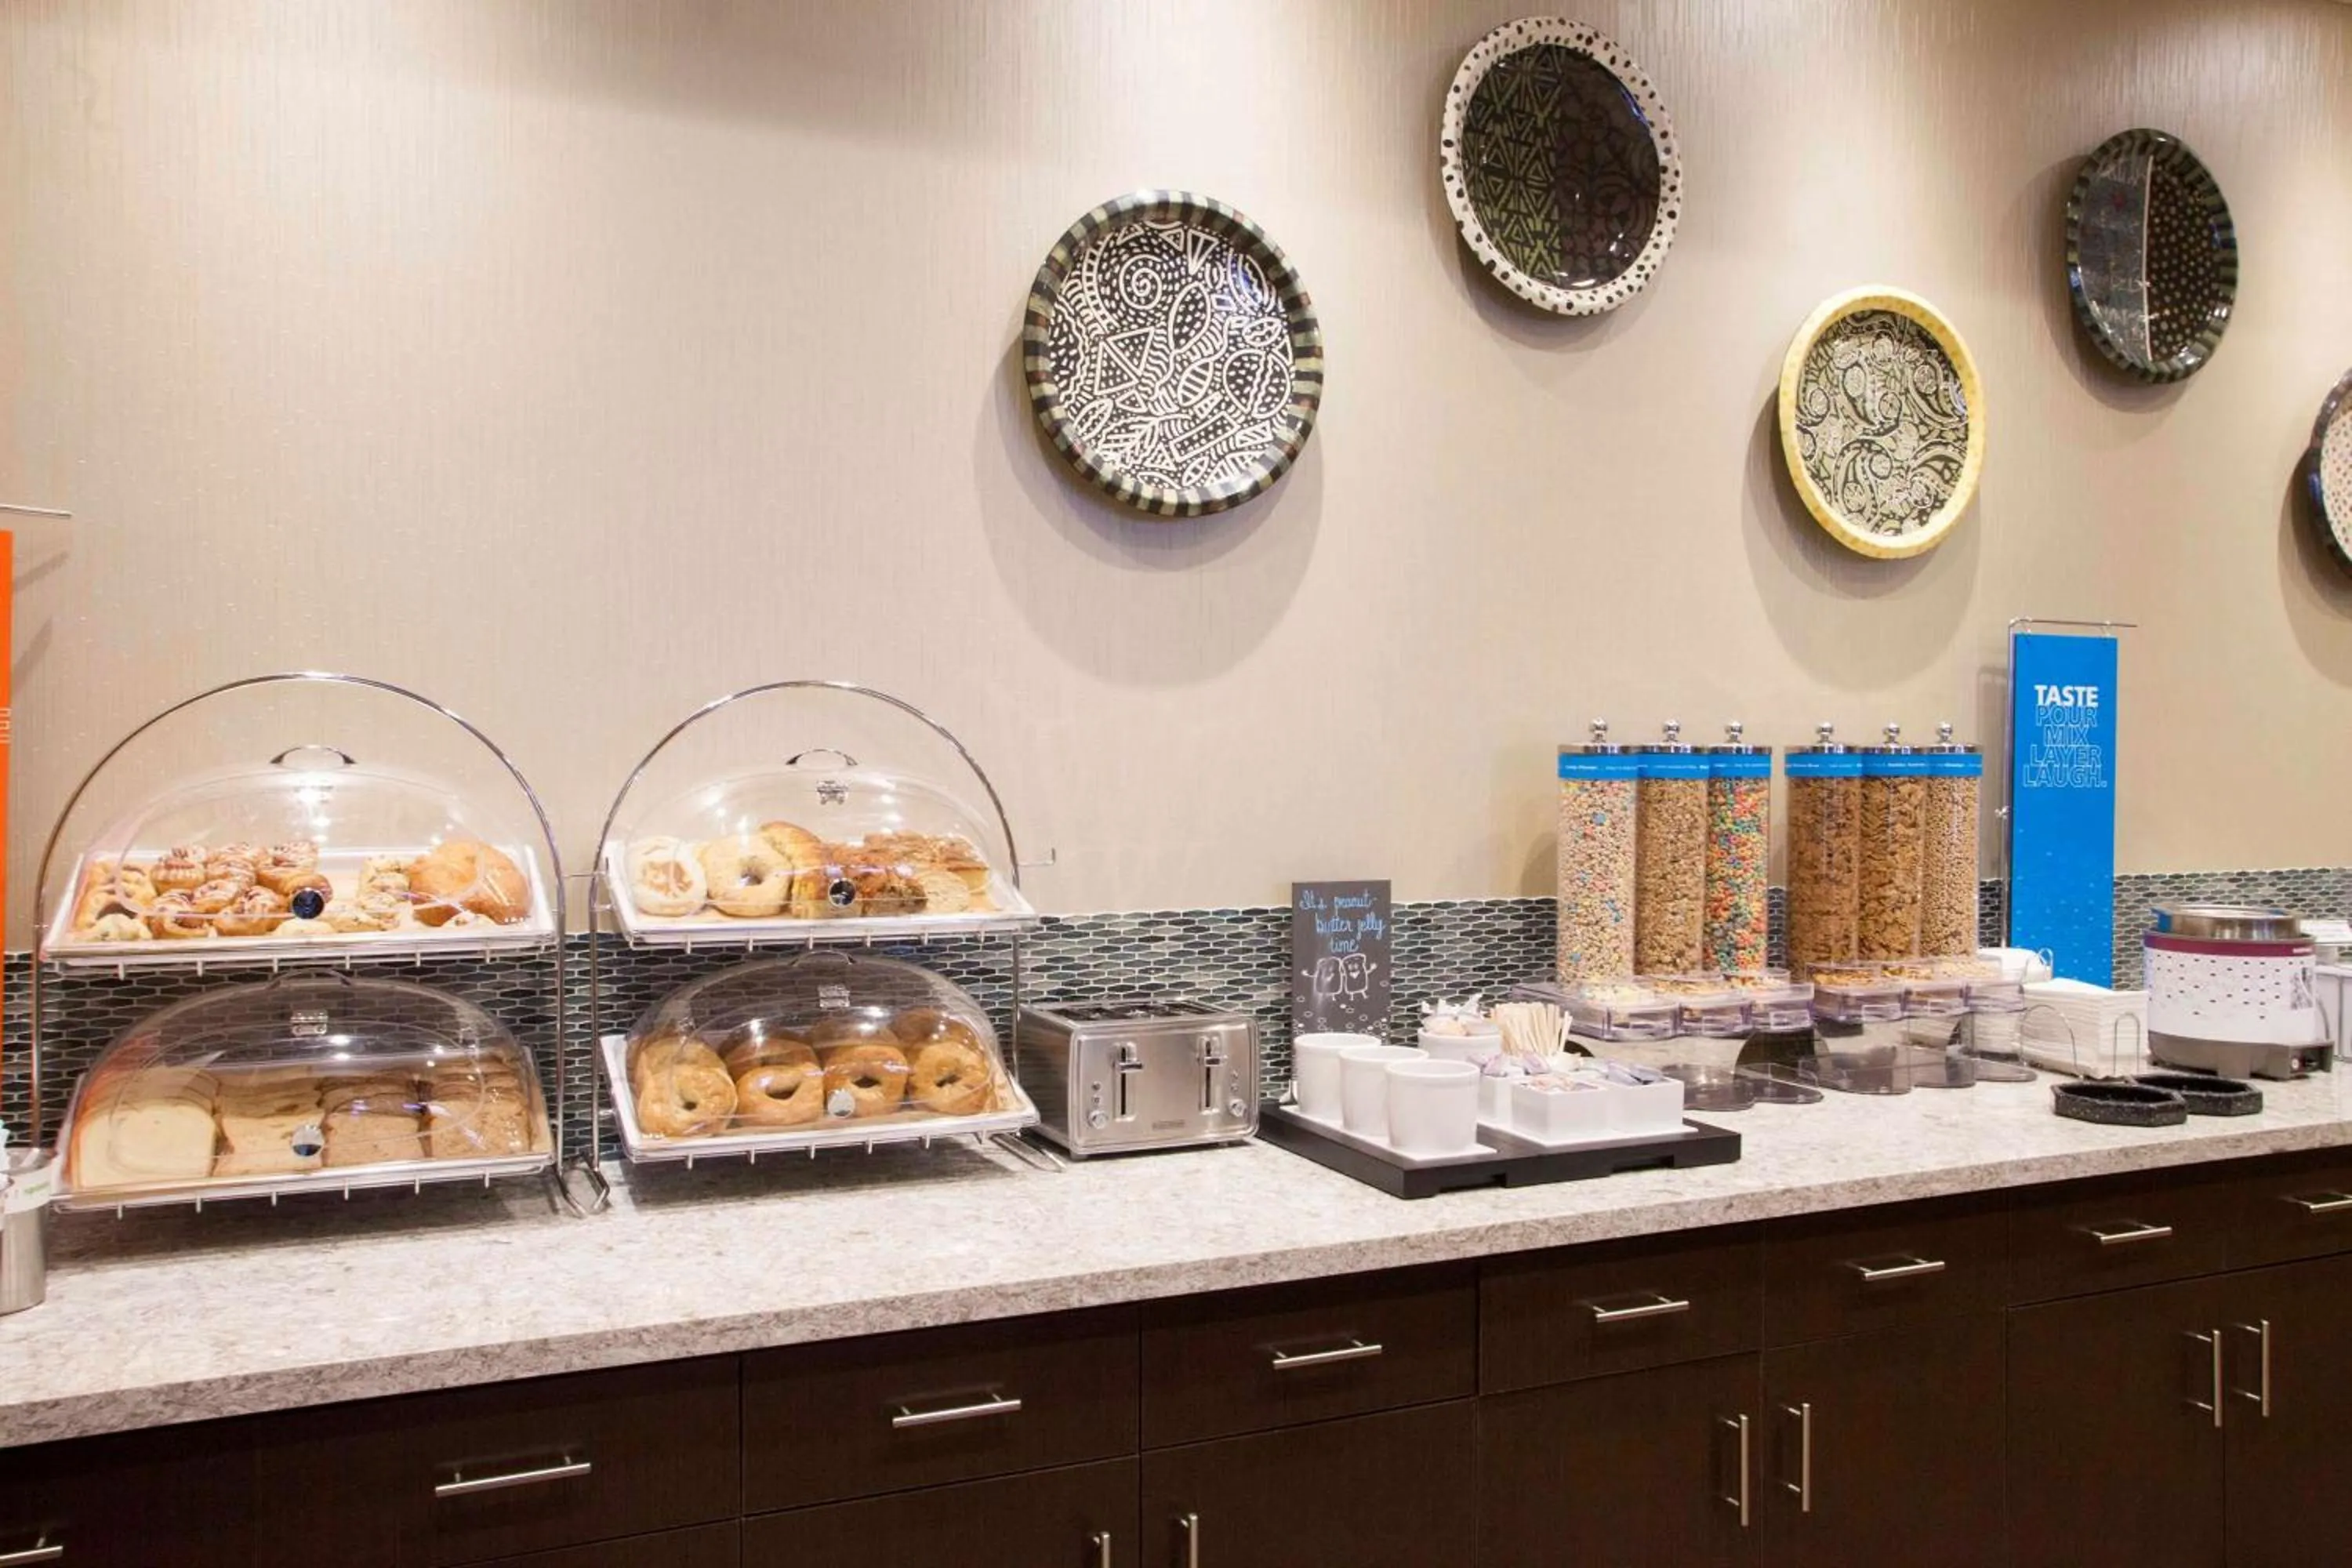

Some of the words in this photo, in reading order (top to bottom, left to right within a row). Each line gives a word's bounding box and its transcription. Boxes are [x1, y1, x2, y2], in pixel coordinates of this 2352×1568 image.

[2034, 684, 2099, 707] TASTE
[2036, 706, 2097, 727] POUR
[2044, 724, 2089, 746] MIX
[2030, 744, 2102, 767] LAYER
[2023, 764, 2107, 788] LAUGH.
[1315, 912, 1353, 934] butter
[1356, 911, 1386, 940] jelly
